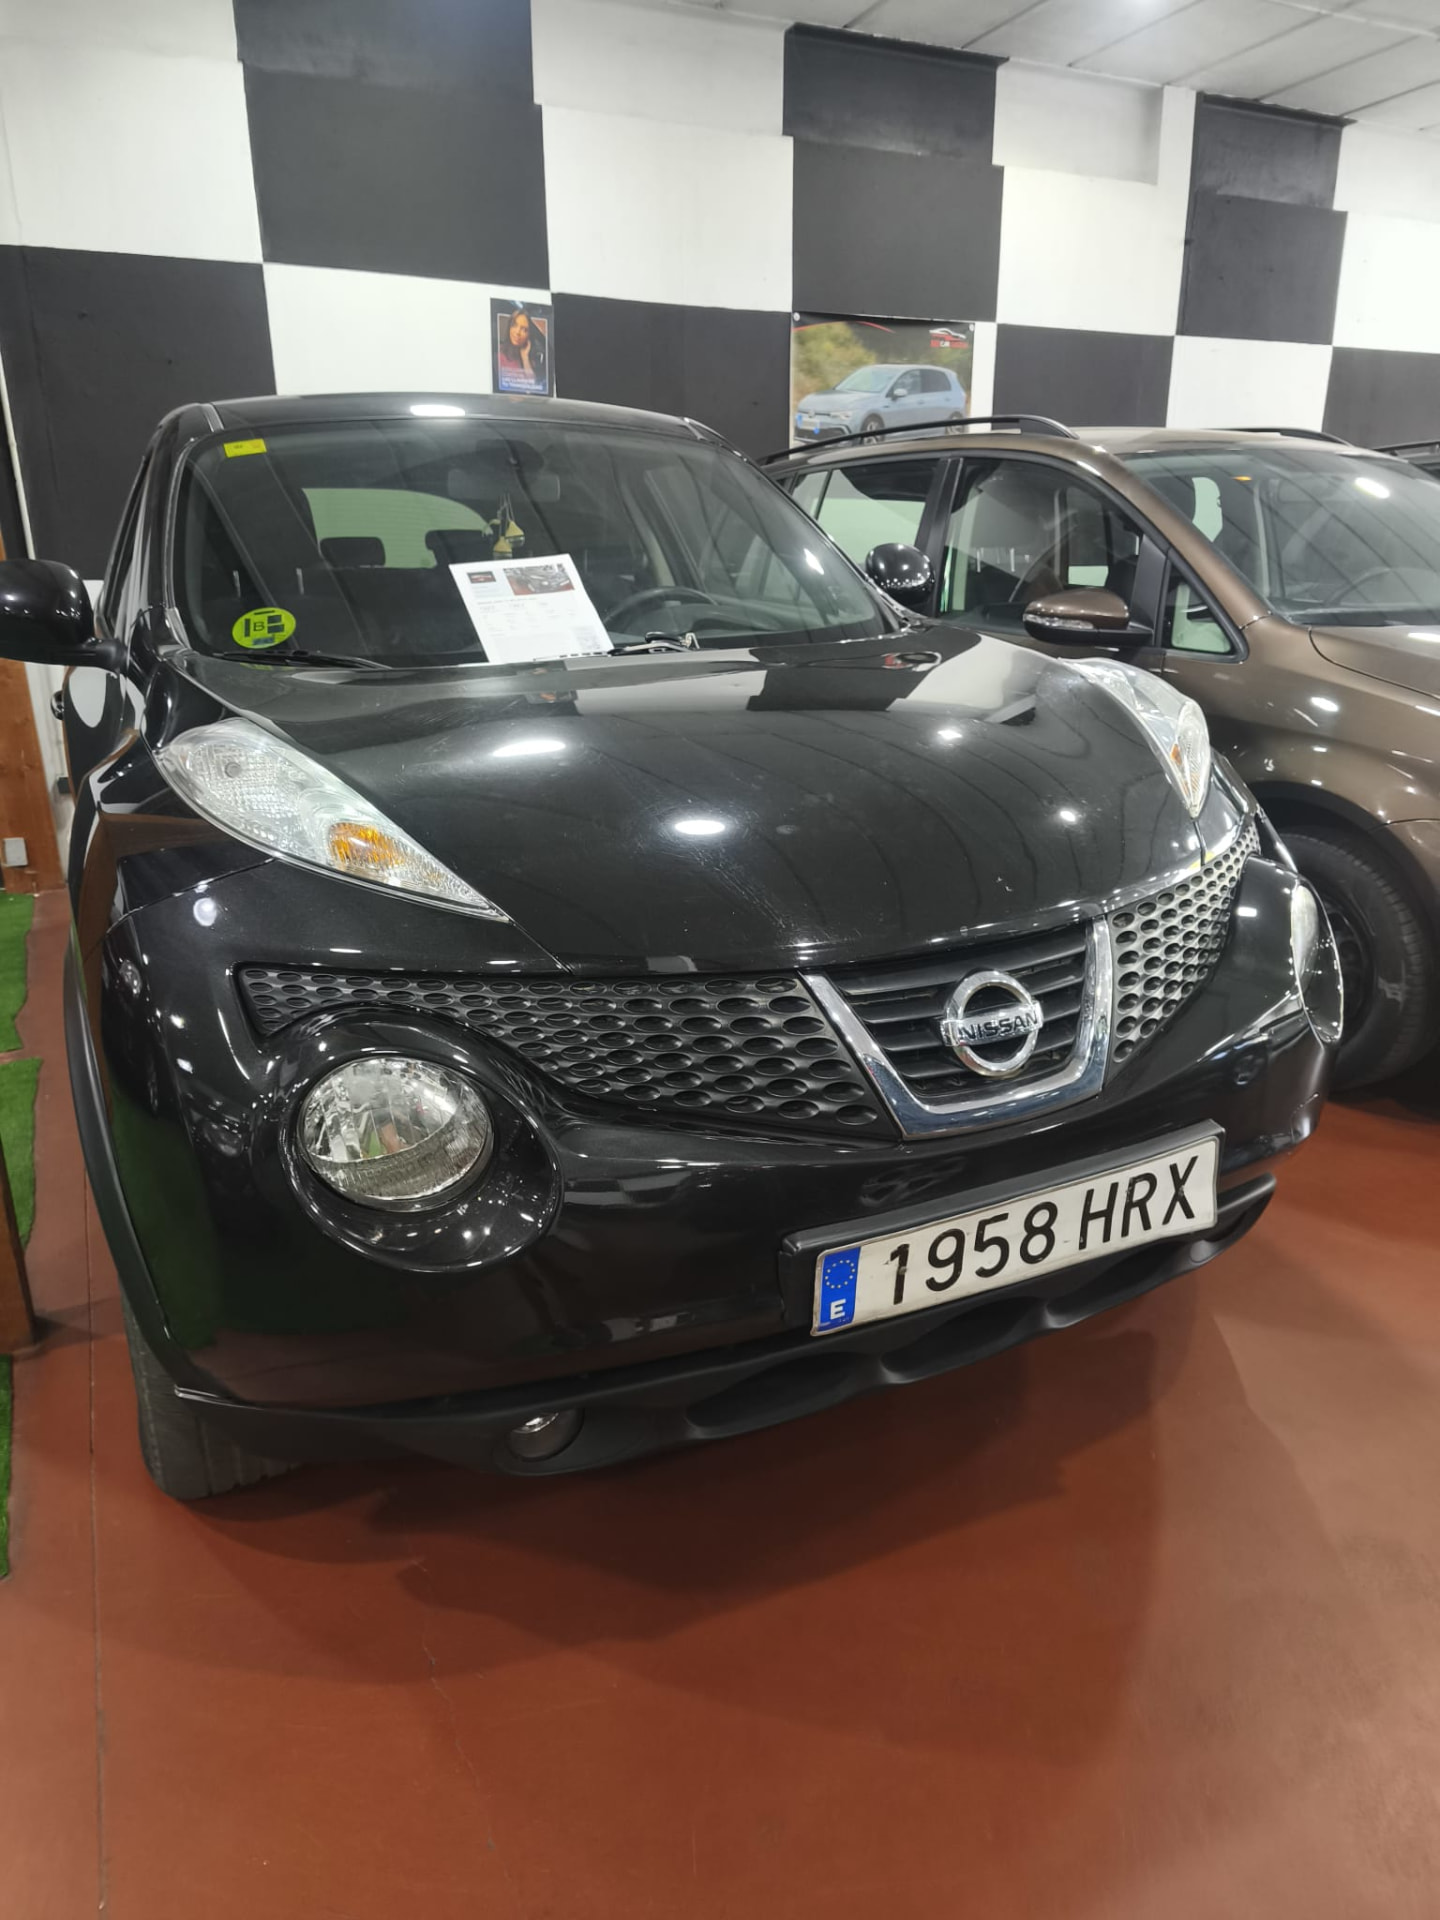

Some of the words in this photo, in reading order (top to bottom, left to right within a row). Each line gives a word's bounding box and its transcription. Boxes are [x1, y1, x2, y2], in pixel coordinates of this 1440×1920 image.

[253, 621, 265, 632] B
[958, 1012, 1038, 1040] NISSAN
[829, 1298, 847, 1320] E
[887, 1201, 1059, 1306] 1958
[1078, 1155, 1199, 1251] HRX
